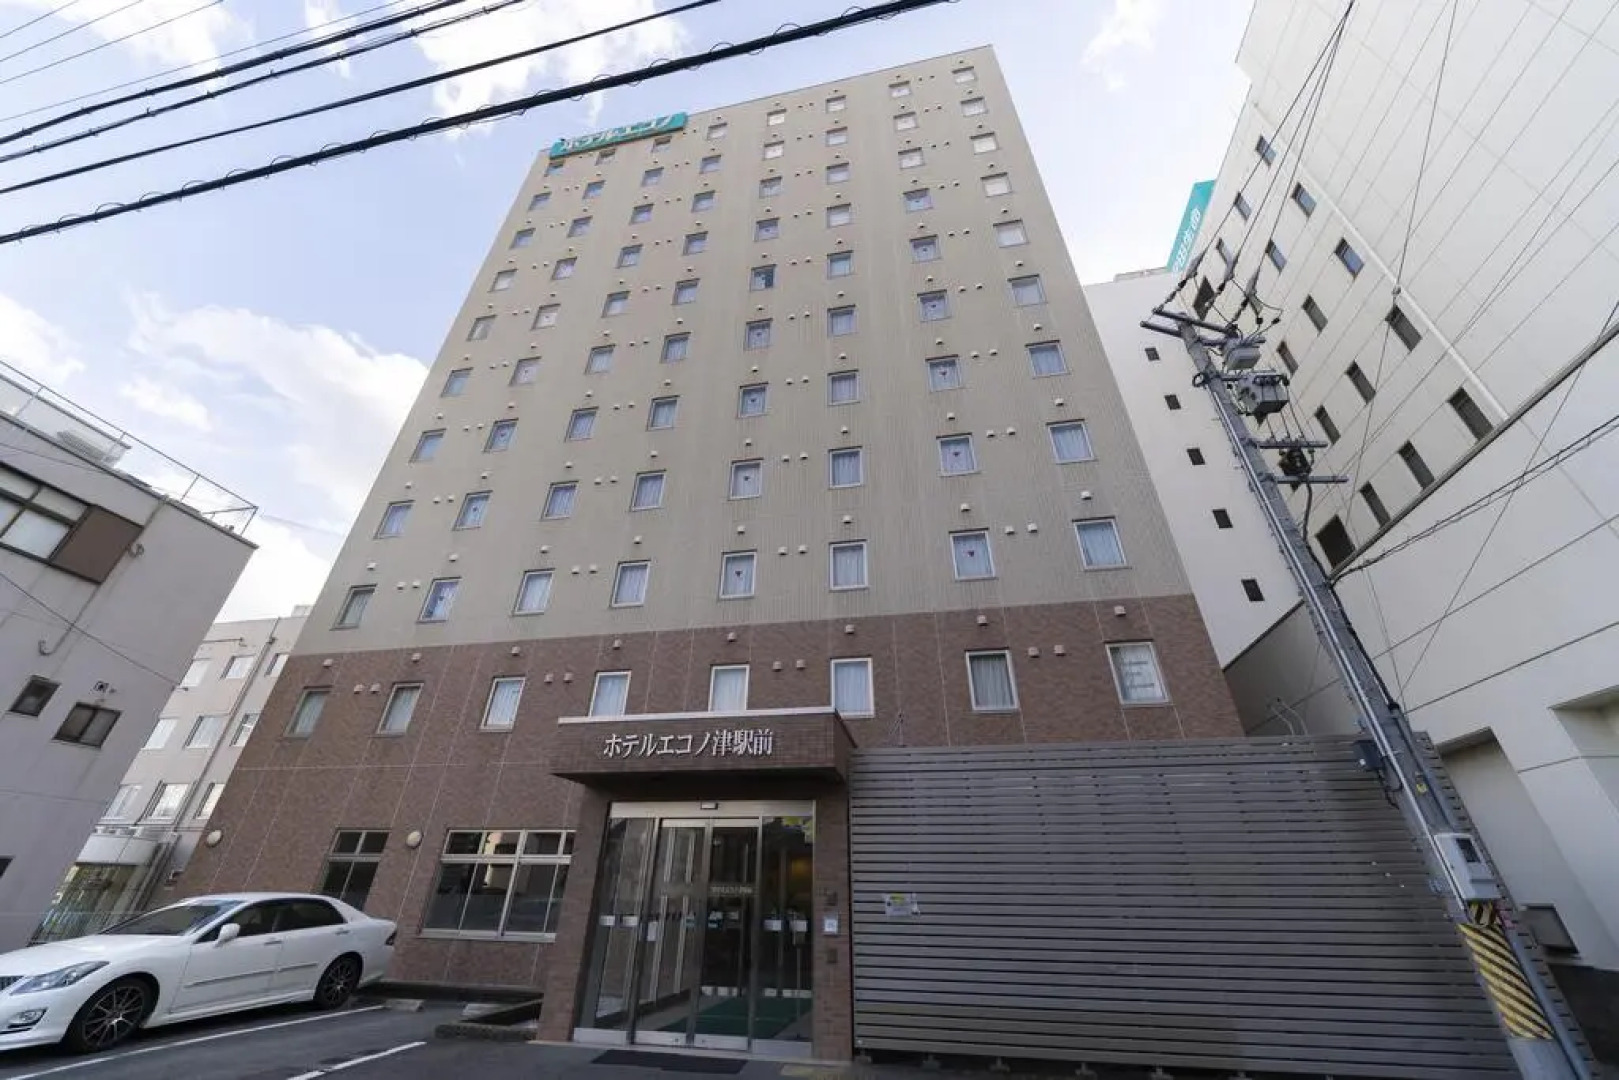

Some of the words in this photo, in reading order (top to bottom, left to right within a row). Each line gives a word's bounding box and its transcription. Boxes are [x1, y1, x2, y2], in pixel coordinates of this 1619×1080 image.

[603, 728, 774, 757] ホテルエコノ津駅前
